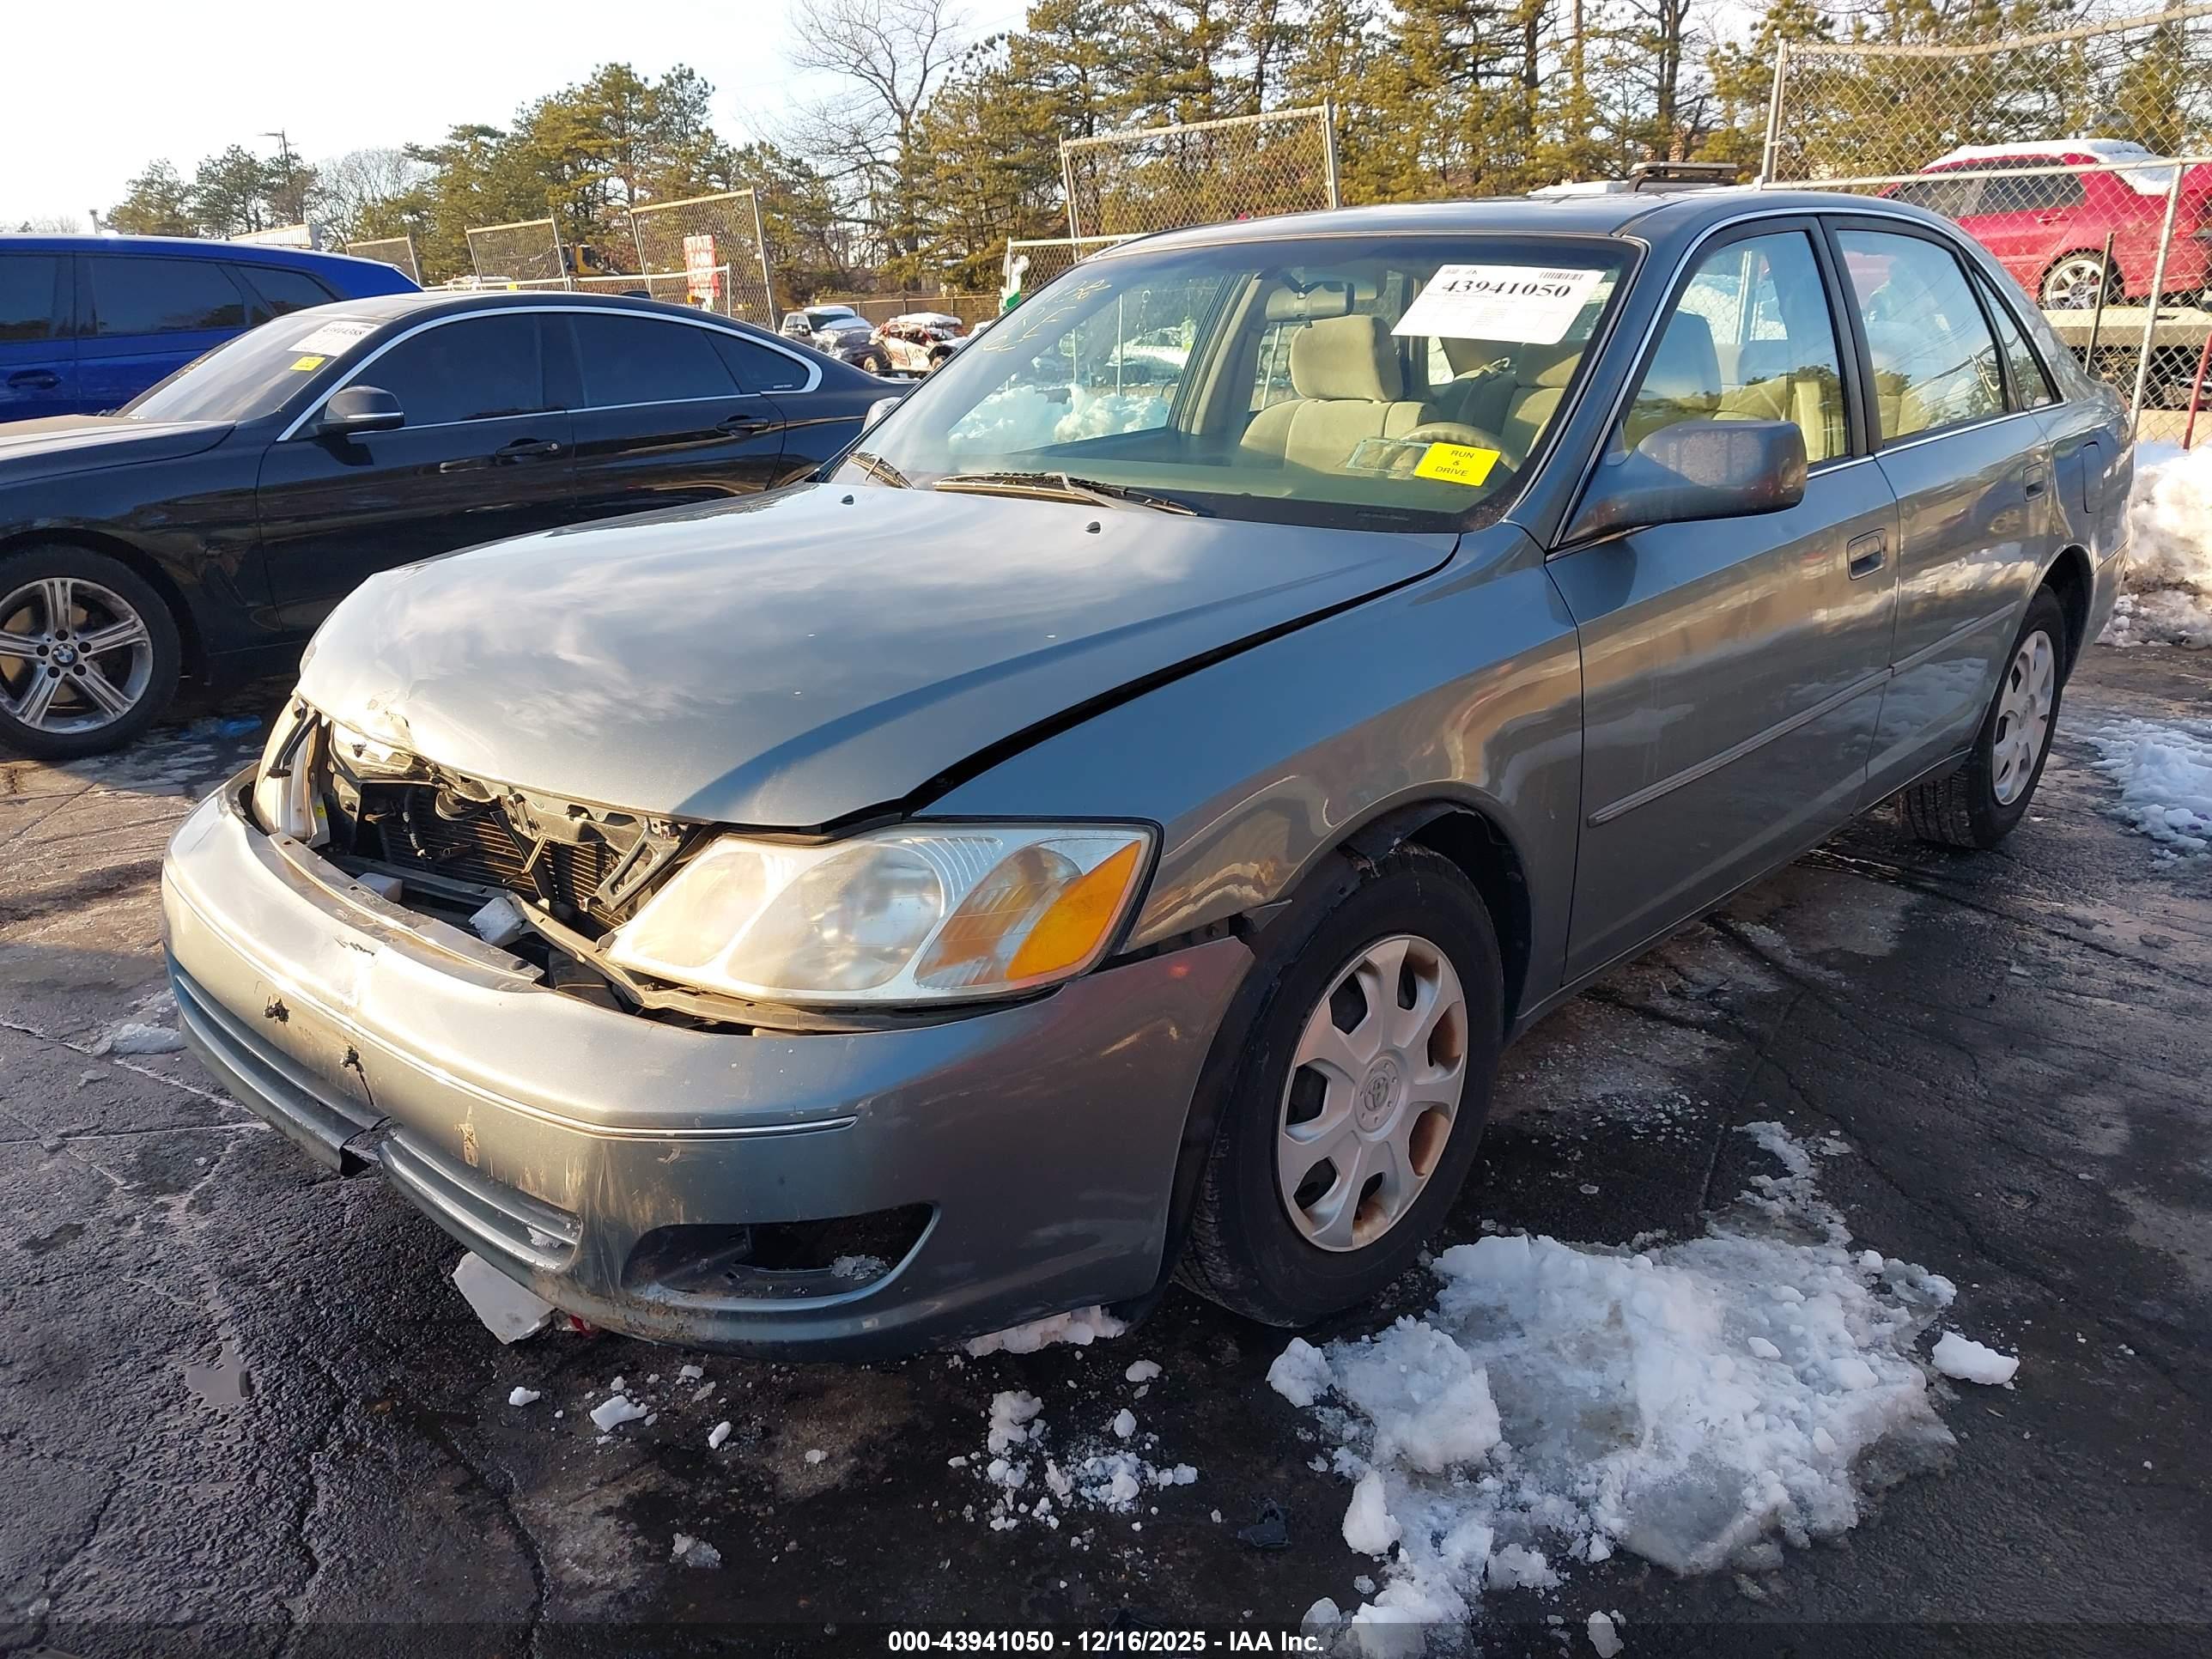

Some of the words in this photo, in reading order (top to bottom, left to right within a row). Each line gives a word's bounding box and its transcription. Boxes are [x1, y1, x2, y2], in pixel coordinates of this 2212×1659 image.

[685, 237, 713, 251] STATE
[1442, 279, 1571, 298] 43941050
[1450, 450, 1475, 459] RUN
[1435, 465, 1469, 477] DRIVE
